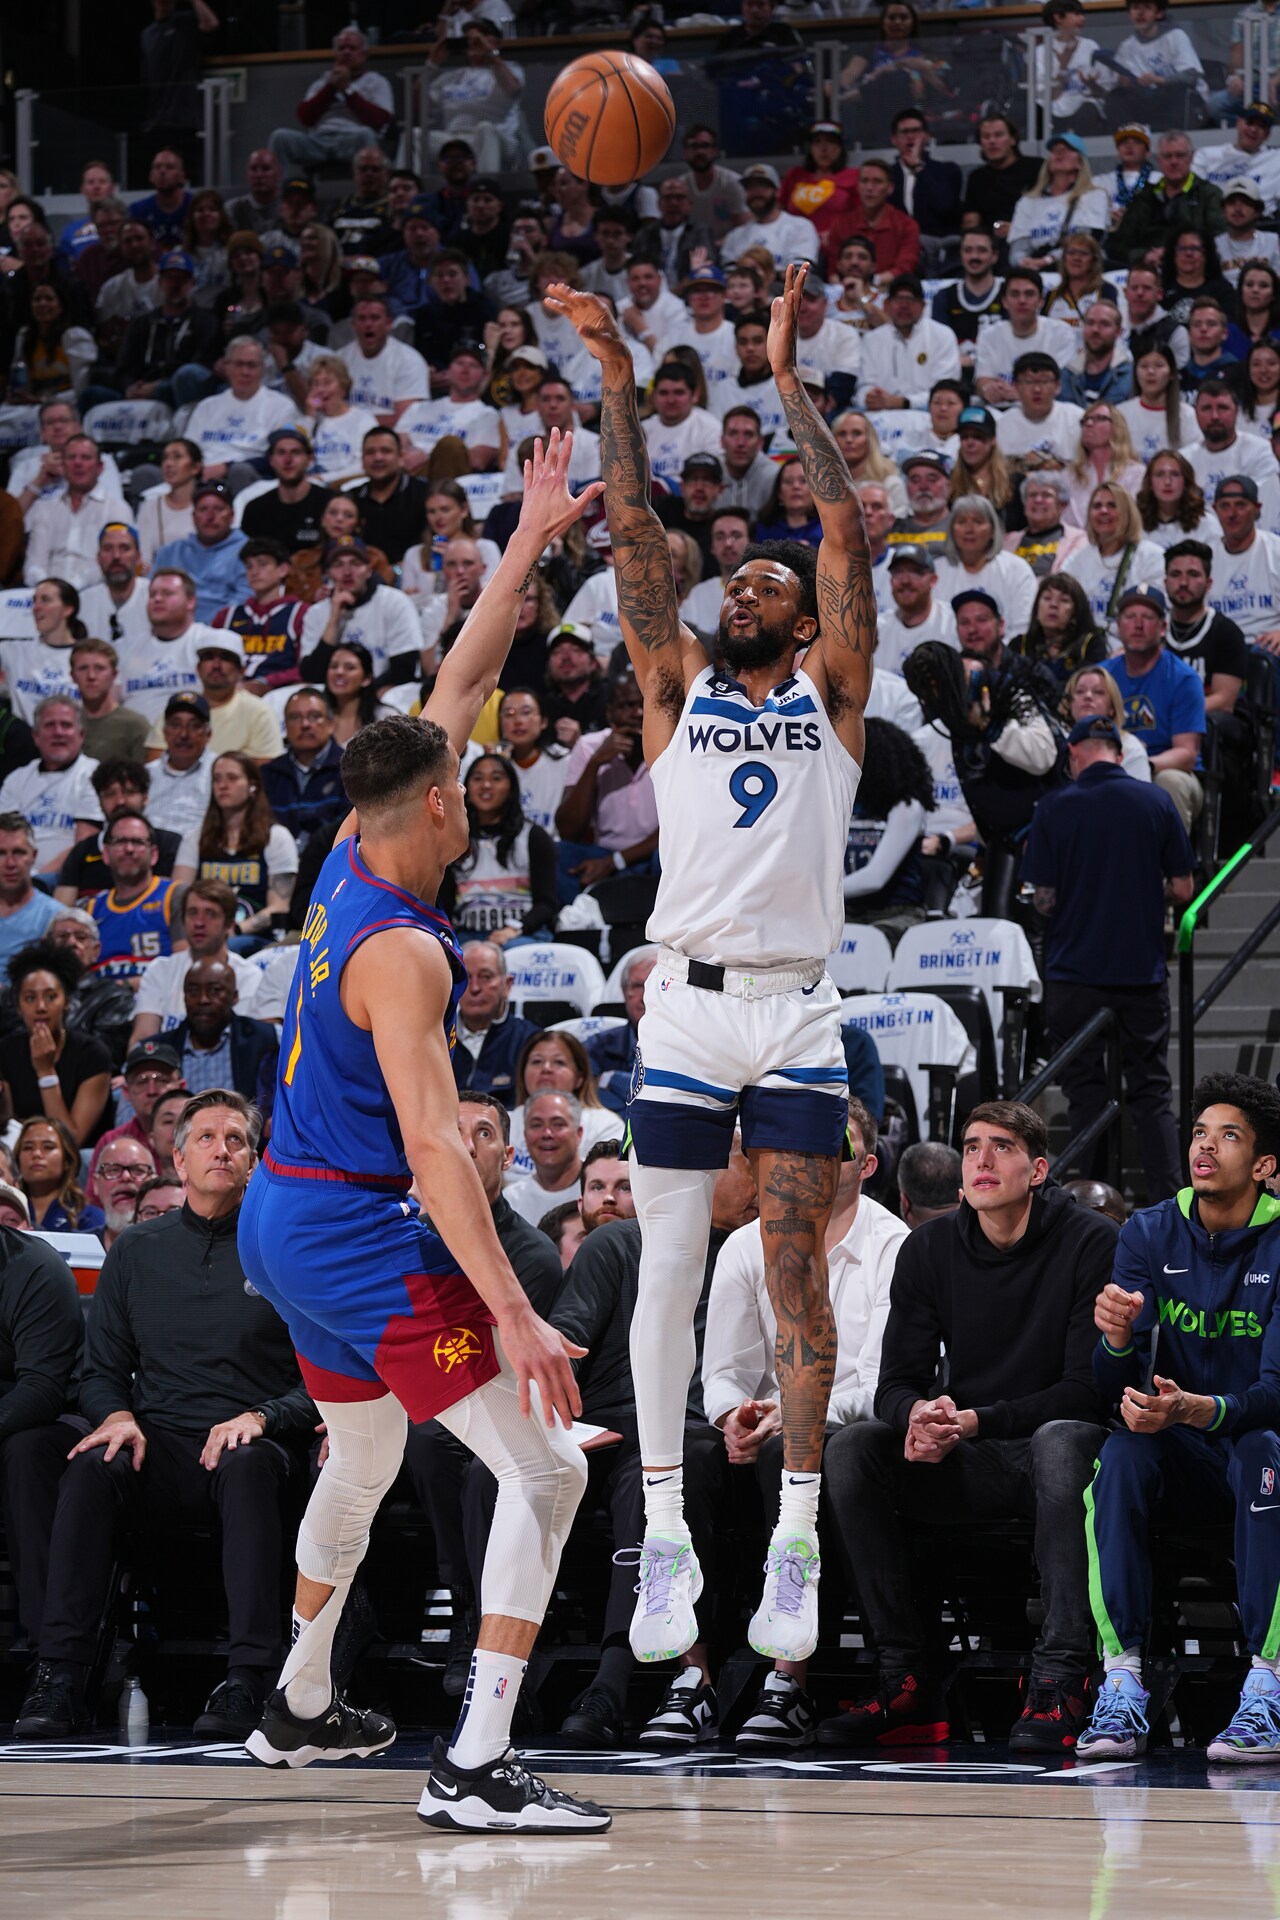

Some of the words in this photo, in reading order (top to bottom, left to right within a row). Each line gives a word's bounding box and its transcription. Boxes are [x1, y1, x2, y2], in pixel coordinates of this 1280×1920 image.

[795, 186, 824, 203] KC
[688, 722, 822, 753] WOLVES
[729, 761, 778, 829] 9
[201, 861, 260, 885] DENVER
[131, 931, 161, 957] 15
[841, 940, 857, 954] IN
[920, 953, 965, 969] BRING
[986, 951, 1001, 966] IN
[510, 972, 541, 986] RING
[561, 972, 576, 986] IN
[849, 1013, 895, 1032] BRING
[918, 1009, 933, 1024] IN
[1249, 1273, 1270, 1284] UHC
[1157, 1296, 1263, 1338] WOLVES
[508, 1748, 1141, 1778] pixel
